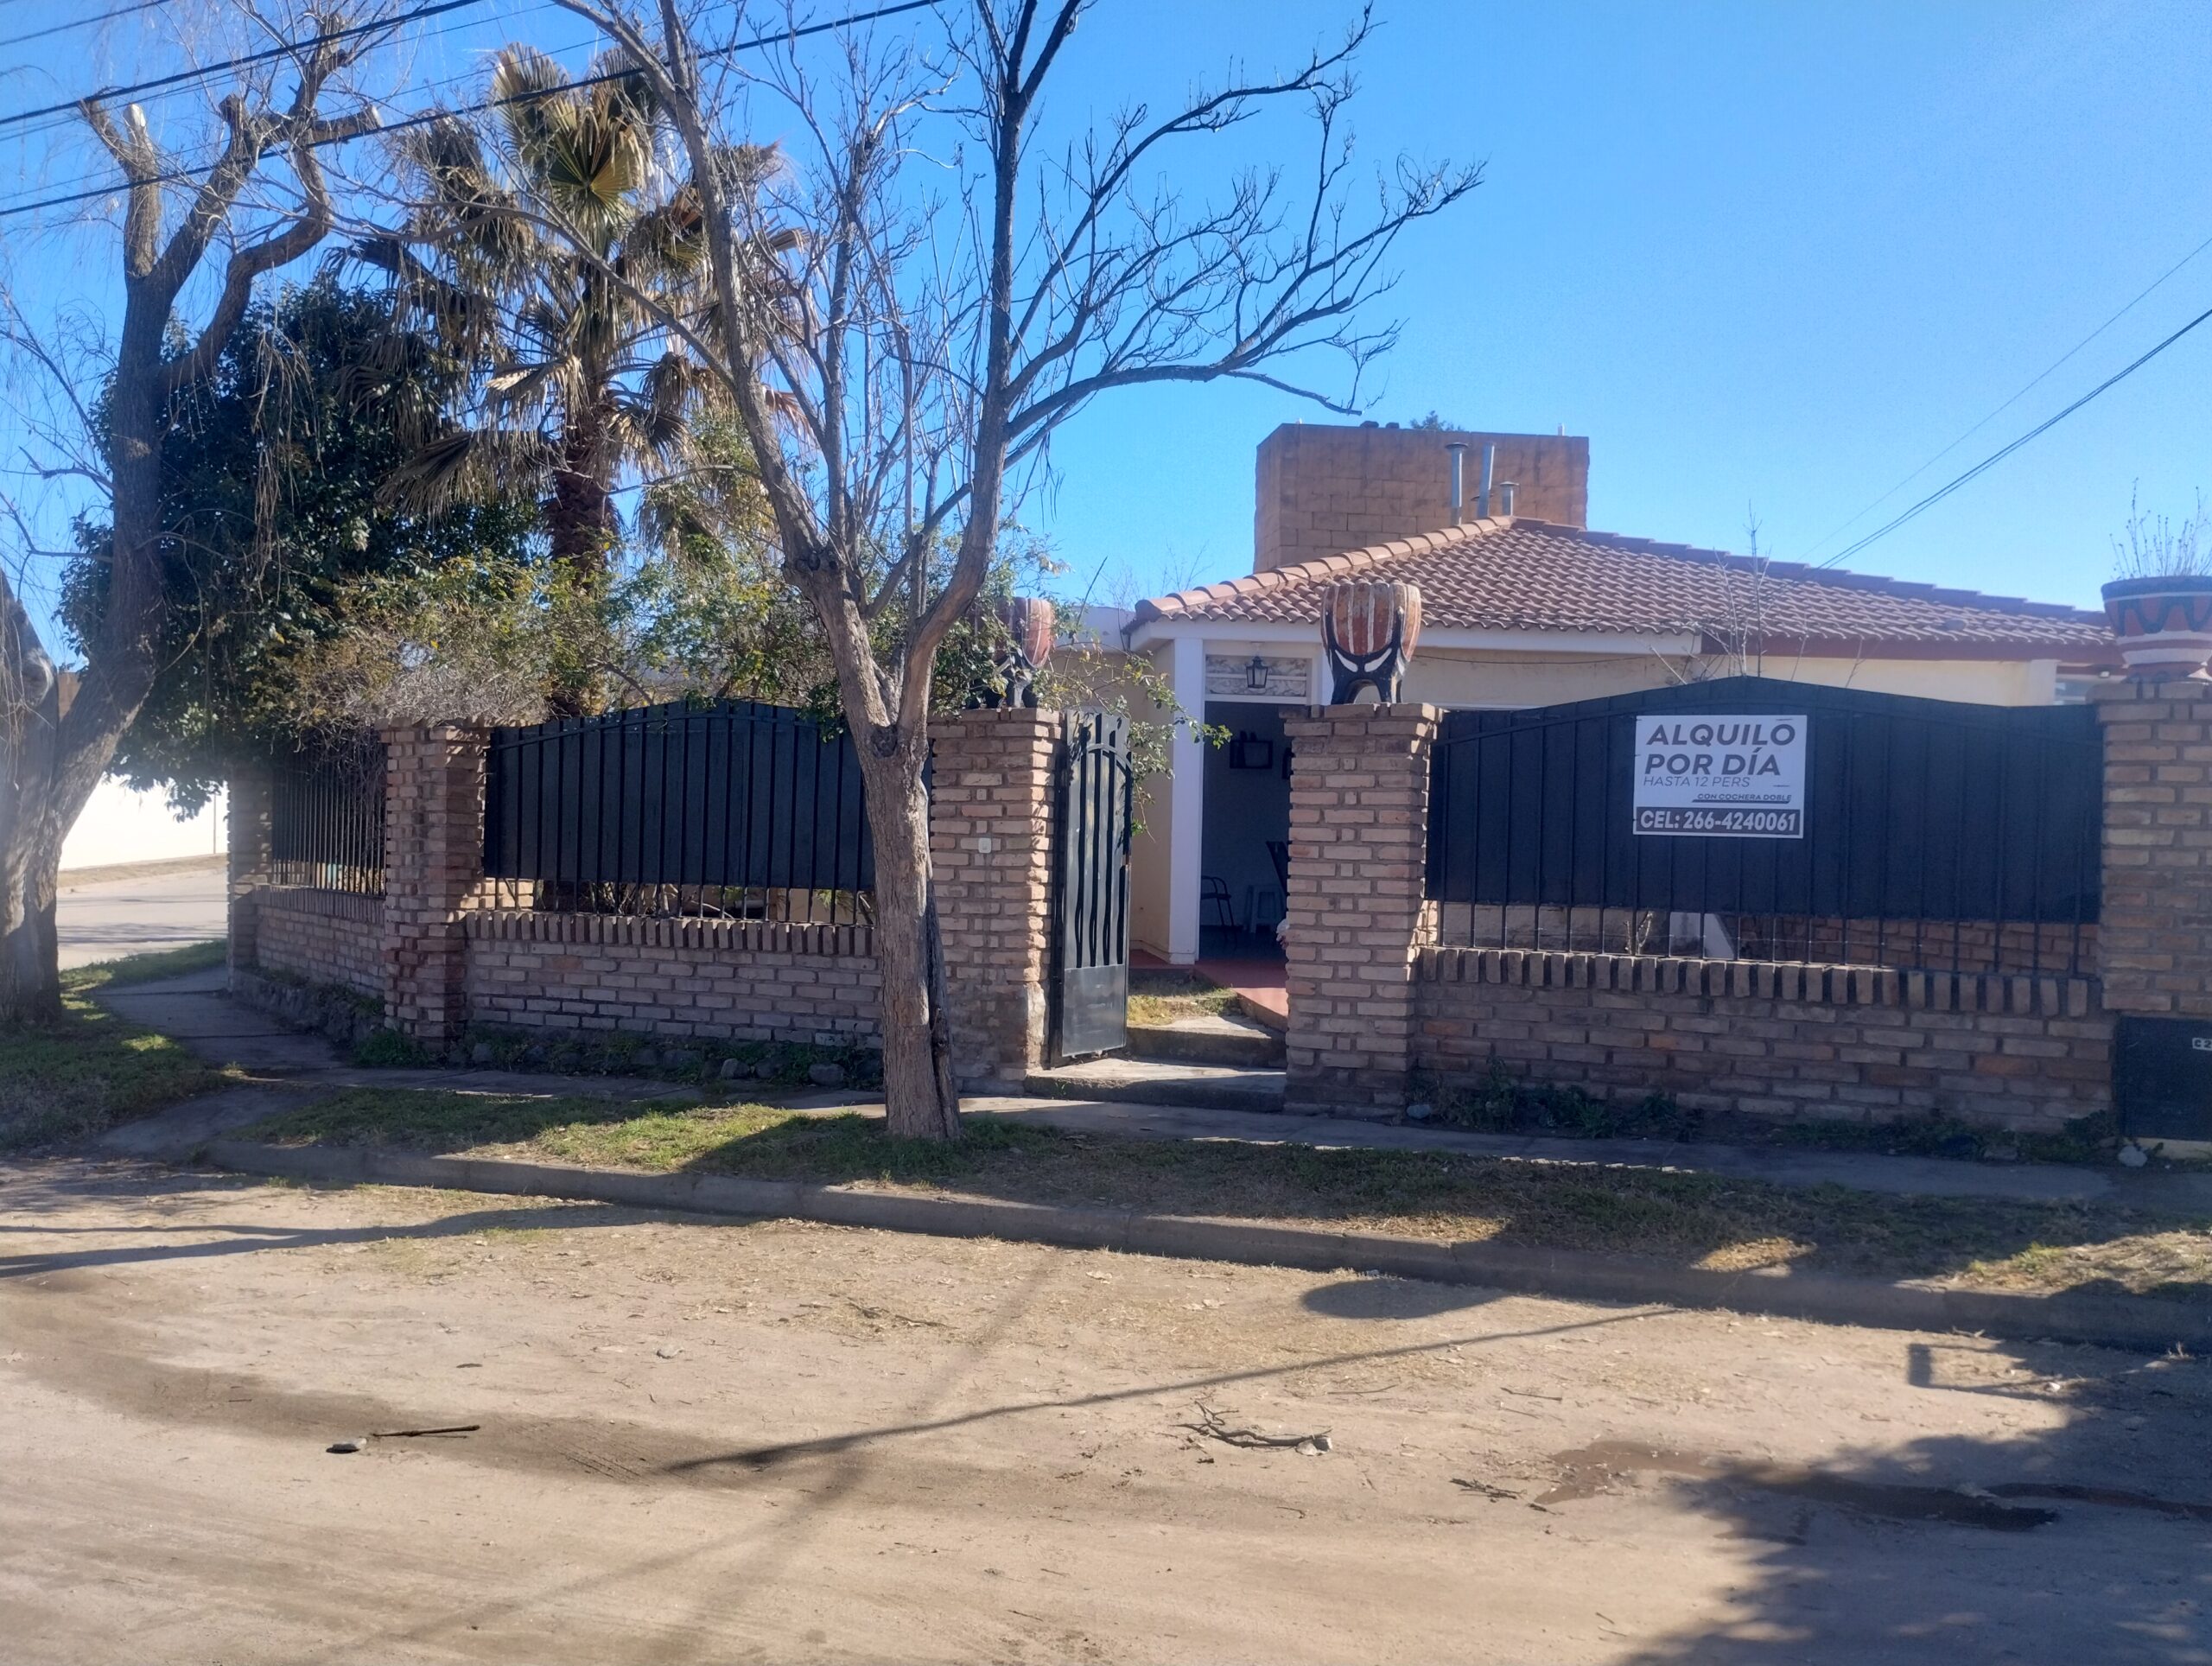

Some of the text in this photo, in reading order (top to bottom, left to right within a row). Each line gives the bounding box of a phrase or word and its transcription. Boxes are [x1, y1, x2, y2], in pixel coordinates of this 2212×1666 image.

[1644, 747, 1781, 776] POR DÍA
[1643, 776, 1751, 787] HASTA 12 PERS
[1641, 810, 1796, 831] CEL: 266-4240061
